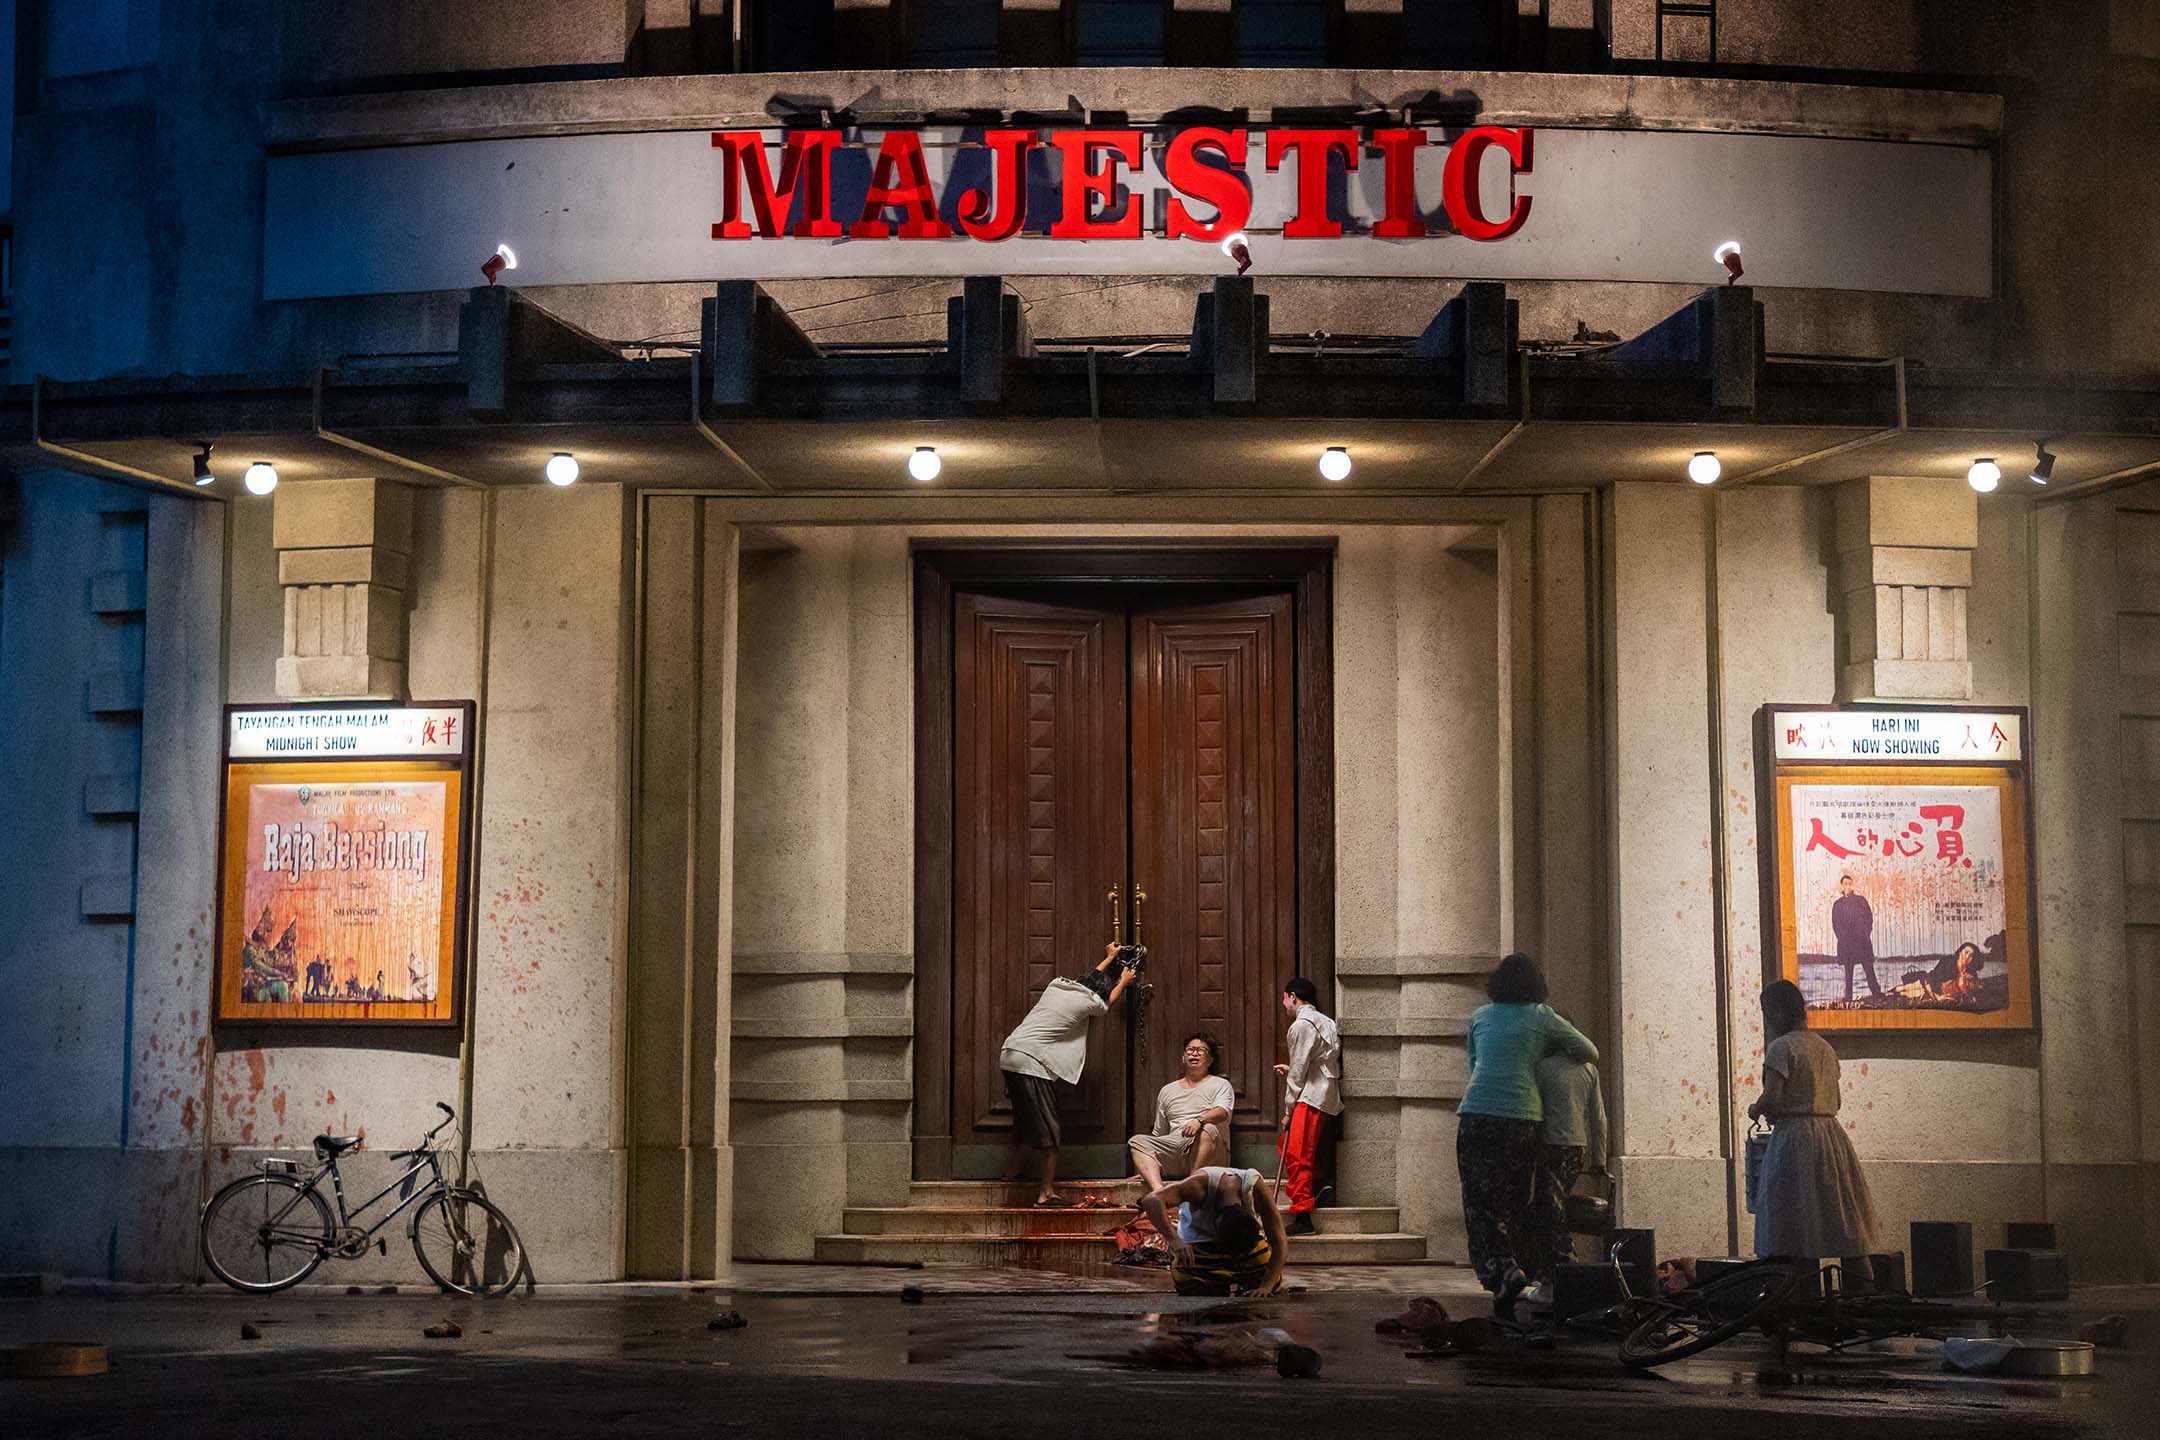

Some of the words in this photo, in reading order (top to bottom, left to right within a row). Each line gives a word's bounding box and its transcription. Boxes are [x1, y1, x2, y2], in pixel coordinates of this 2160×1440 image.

[711, 126, 1534, 242] MAJESTIC
[238, 716, 294, 730] TAYANGAN
[299, 715, 342, 729] TENGAH
[347, 713, 389, 728] MALAM
[1872, 718, 1900, 733] HARI
[1904, 718, 1920, 733] INI
[266, 736, 319, 751] MIDNIGHT
[324, 736, 357, 750] SHOW
[1852, 739, 1880, 754] NOW
[1884, 739, 1940, 754] SHOWING
[264, 822, 315, 883] Raja
[321, 821, 428, 883] Bersiong
